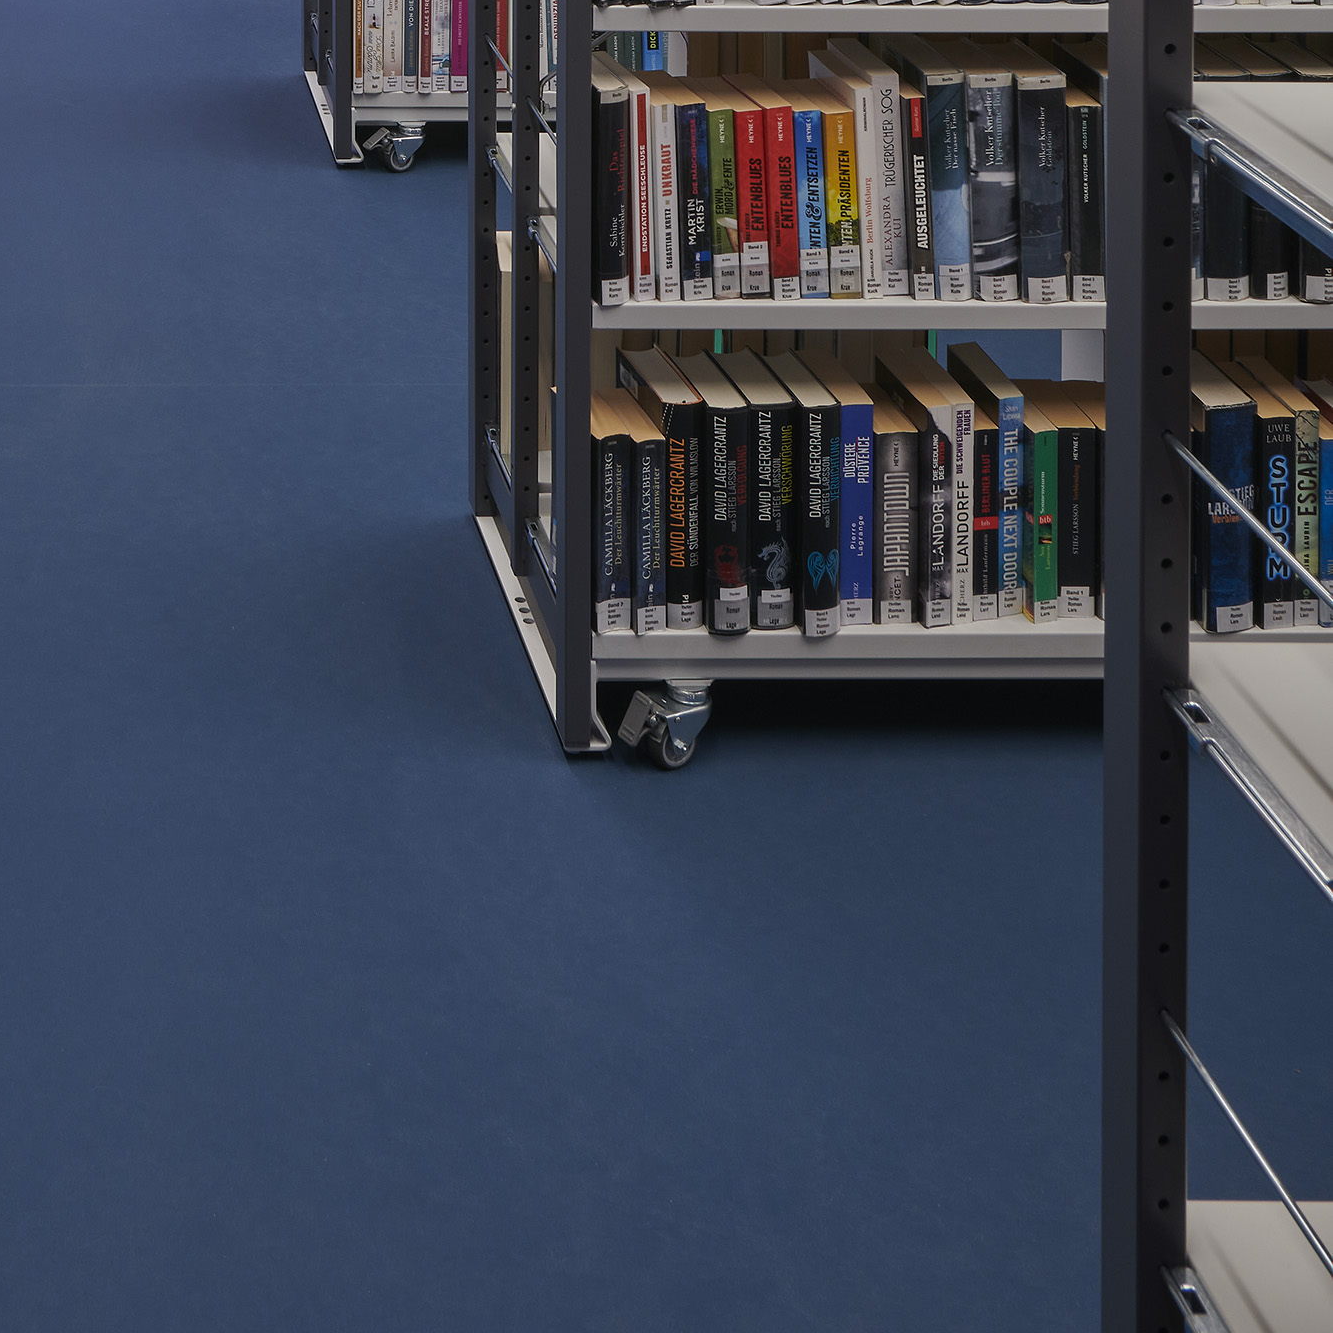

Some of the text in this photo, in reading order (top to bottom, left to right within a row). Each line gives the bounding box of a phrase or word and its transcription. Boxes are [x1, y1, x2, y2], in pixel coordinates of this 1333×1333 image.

[880, 88, 897, 188] TRÜGERISCHER SOG
[983, 90, 994, 166] Volker Kutscher
[661, 143, 672, 197] UNKRAUT
[749, 158, 765, 234] ENTENBLUES
[806, 147, 819, 202] ENTSETZEN
[838, 149, 852, 217] PRÄSIDENTEN
[913, 154, 929, 249] AUSGELEUCHTET
[639, 194, 648, 252] ENDSTATION
[883, 195, 894, 265] ALEXANDRA
[893, 217, 902, 238] KUI
[1004, 429, 1019, 455] THE
[1266, 433, 1292, 443] LAUB
[1267, 424, 1290, 433] UWE
[670, 438, 685, 567] DAVID LAGERCRANTZ
[1003, 459, 1019, 512] COUPLE
[1297, 441, 1317, 516] ESCAPE
[604, 453, 614, 576] CAMILLA LÄCKBERG
[883, 472, 910, 576] JAPANTOWN
[956, 480, 969, 567] LANDORFF
[1003, 513, 1018, 548] NEXT
[1039, 515, 1052, 524] btb
